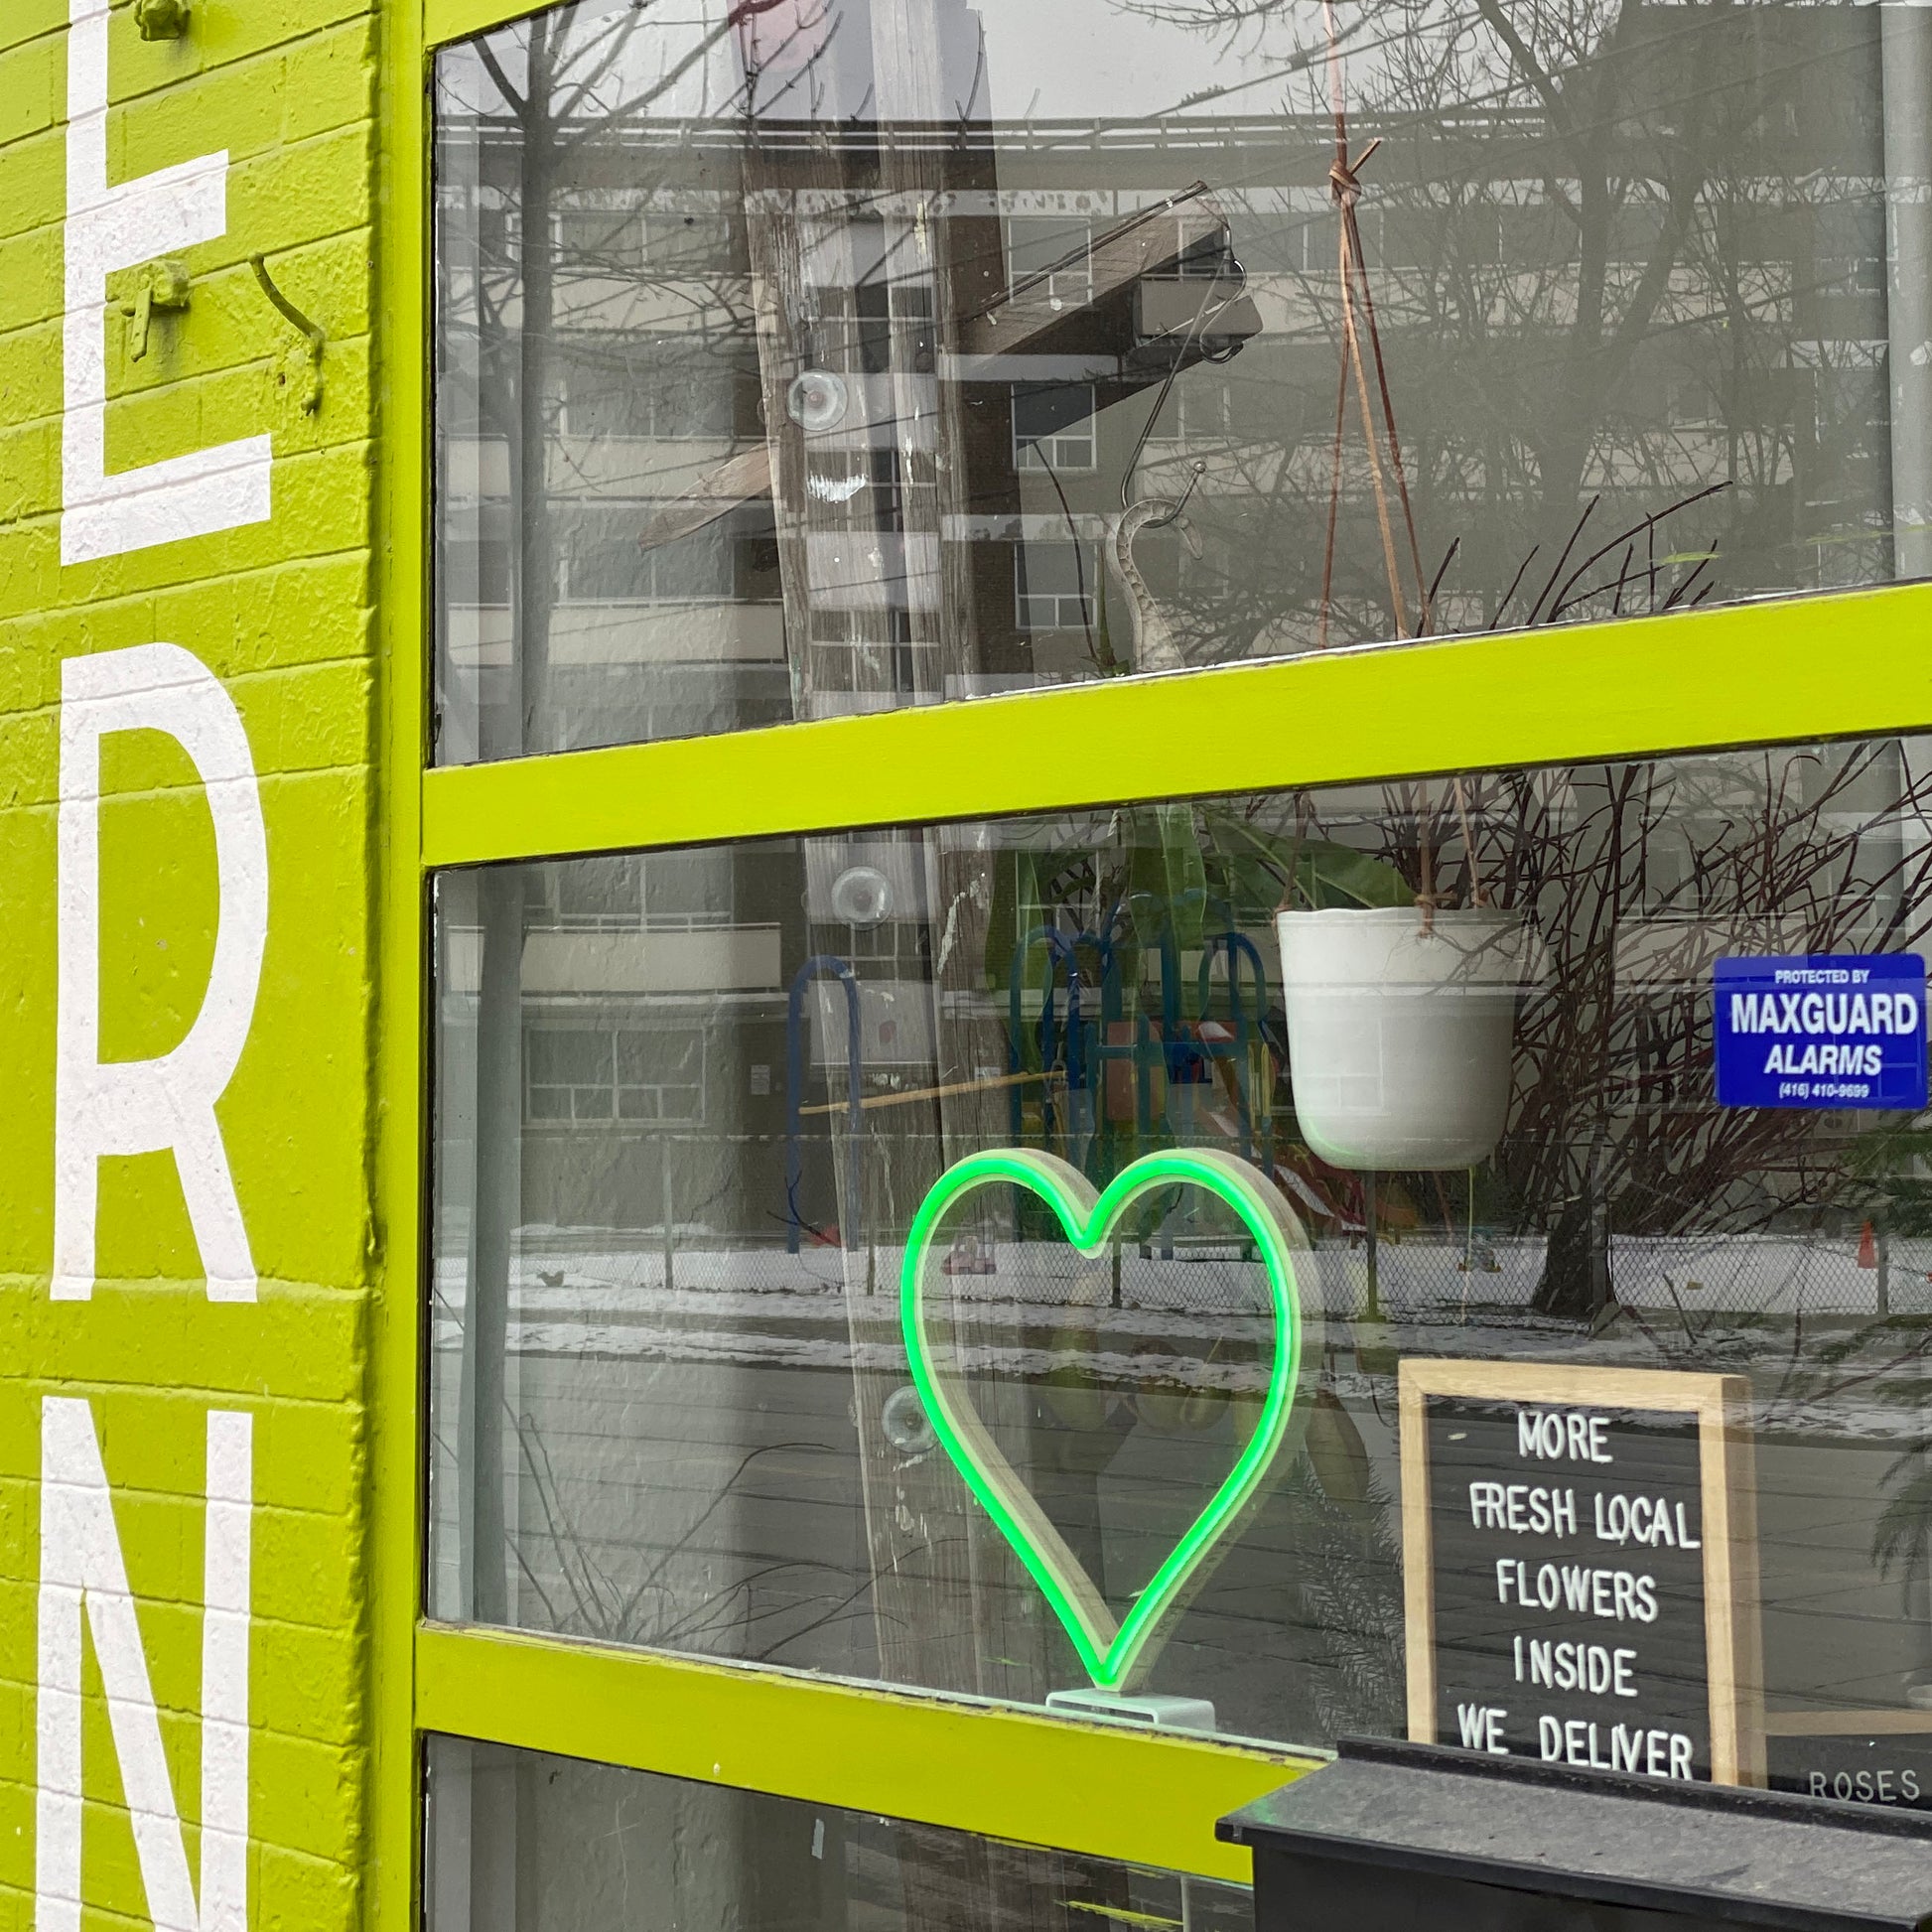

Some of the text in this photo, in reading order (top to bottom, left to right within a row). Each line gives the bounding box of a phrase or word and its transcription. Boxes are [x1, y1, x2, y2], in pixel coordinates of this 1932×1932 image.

[1774, 969, 1870, 984] PROTECTED BY
[1730, 993, 1919, 1035] MAXGUARD
[1763, 1044, 1882, 1076] ALARMS
[1778, 1082, 1810, 1099] (416)
[1517, 1411, 1614, 1464] MORE
[1468, 1481, 1702, 1551] FRESH LOCAL
[1495, 1558, 1660, 1623] FLOWERS
[1513, 1635, 1639, 1698] INSIDE
[1456, 1703, 1695, 1781] WE DELIVER
[1808, 1769, 1921, 1802] ROSES
